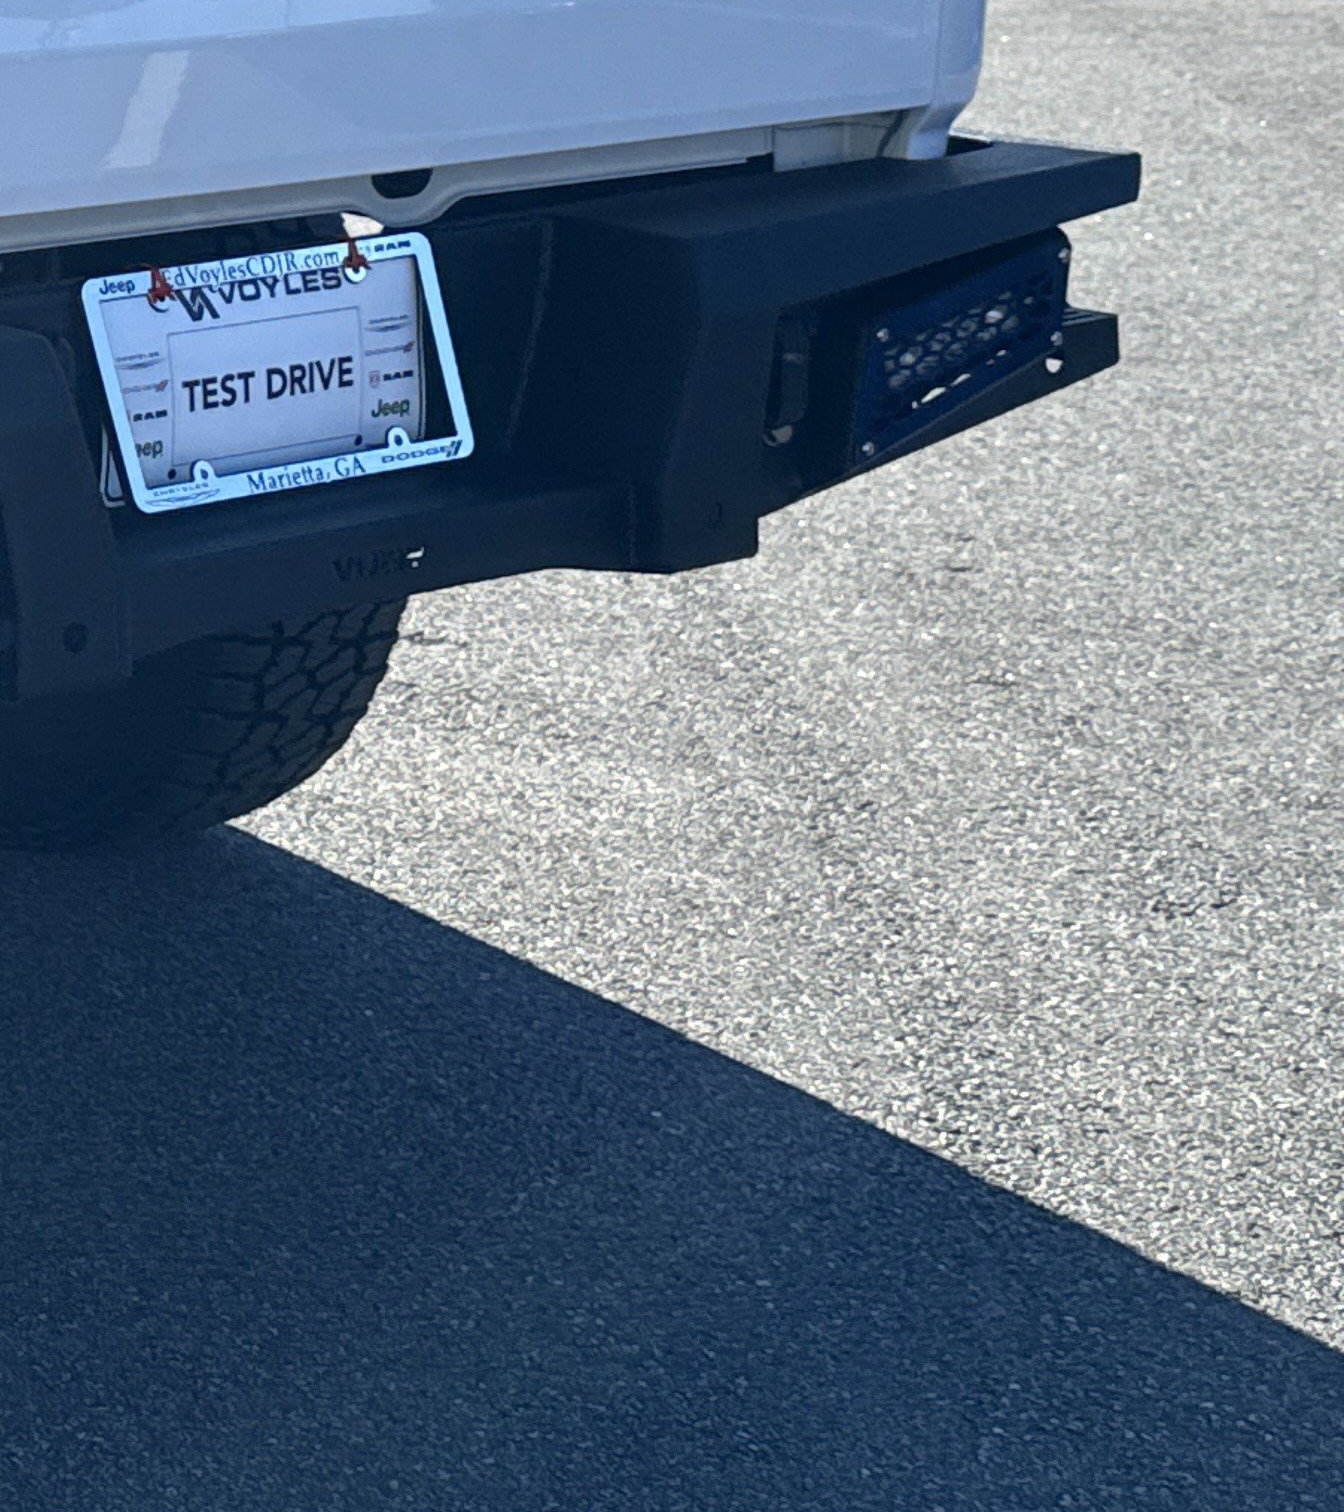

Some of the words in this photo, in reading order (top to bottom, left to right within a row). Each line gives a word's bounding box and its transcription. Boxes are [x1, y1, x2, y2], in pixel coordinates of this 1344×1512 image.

[98, 278, 136, 296] Jeep
[374, 239, 412, 253] RAM
[217, 268, 343, 306] VOYLES
[181, 370, 256, 414] TEST
[265, 355, 355, 401] DRIVE
[371, 398, 410, 418] Jeep
[134, 440, 164, 460] eep
[246, 461, 331, 495] Marietta,
[334, 456, 367, 479] GA
